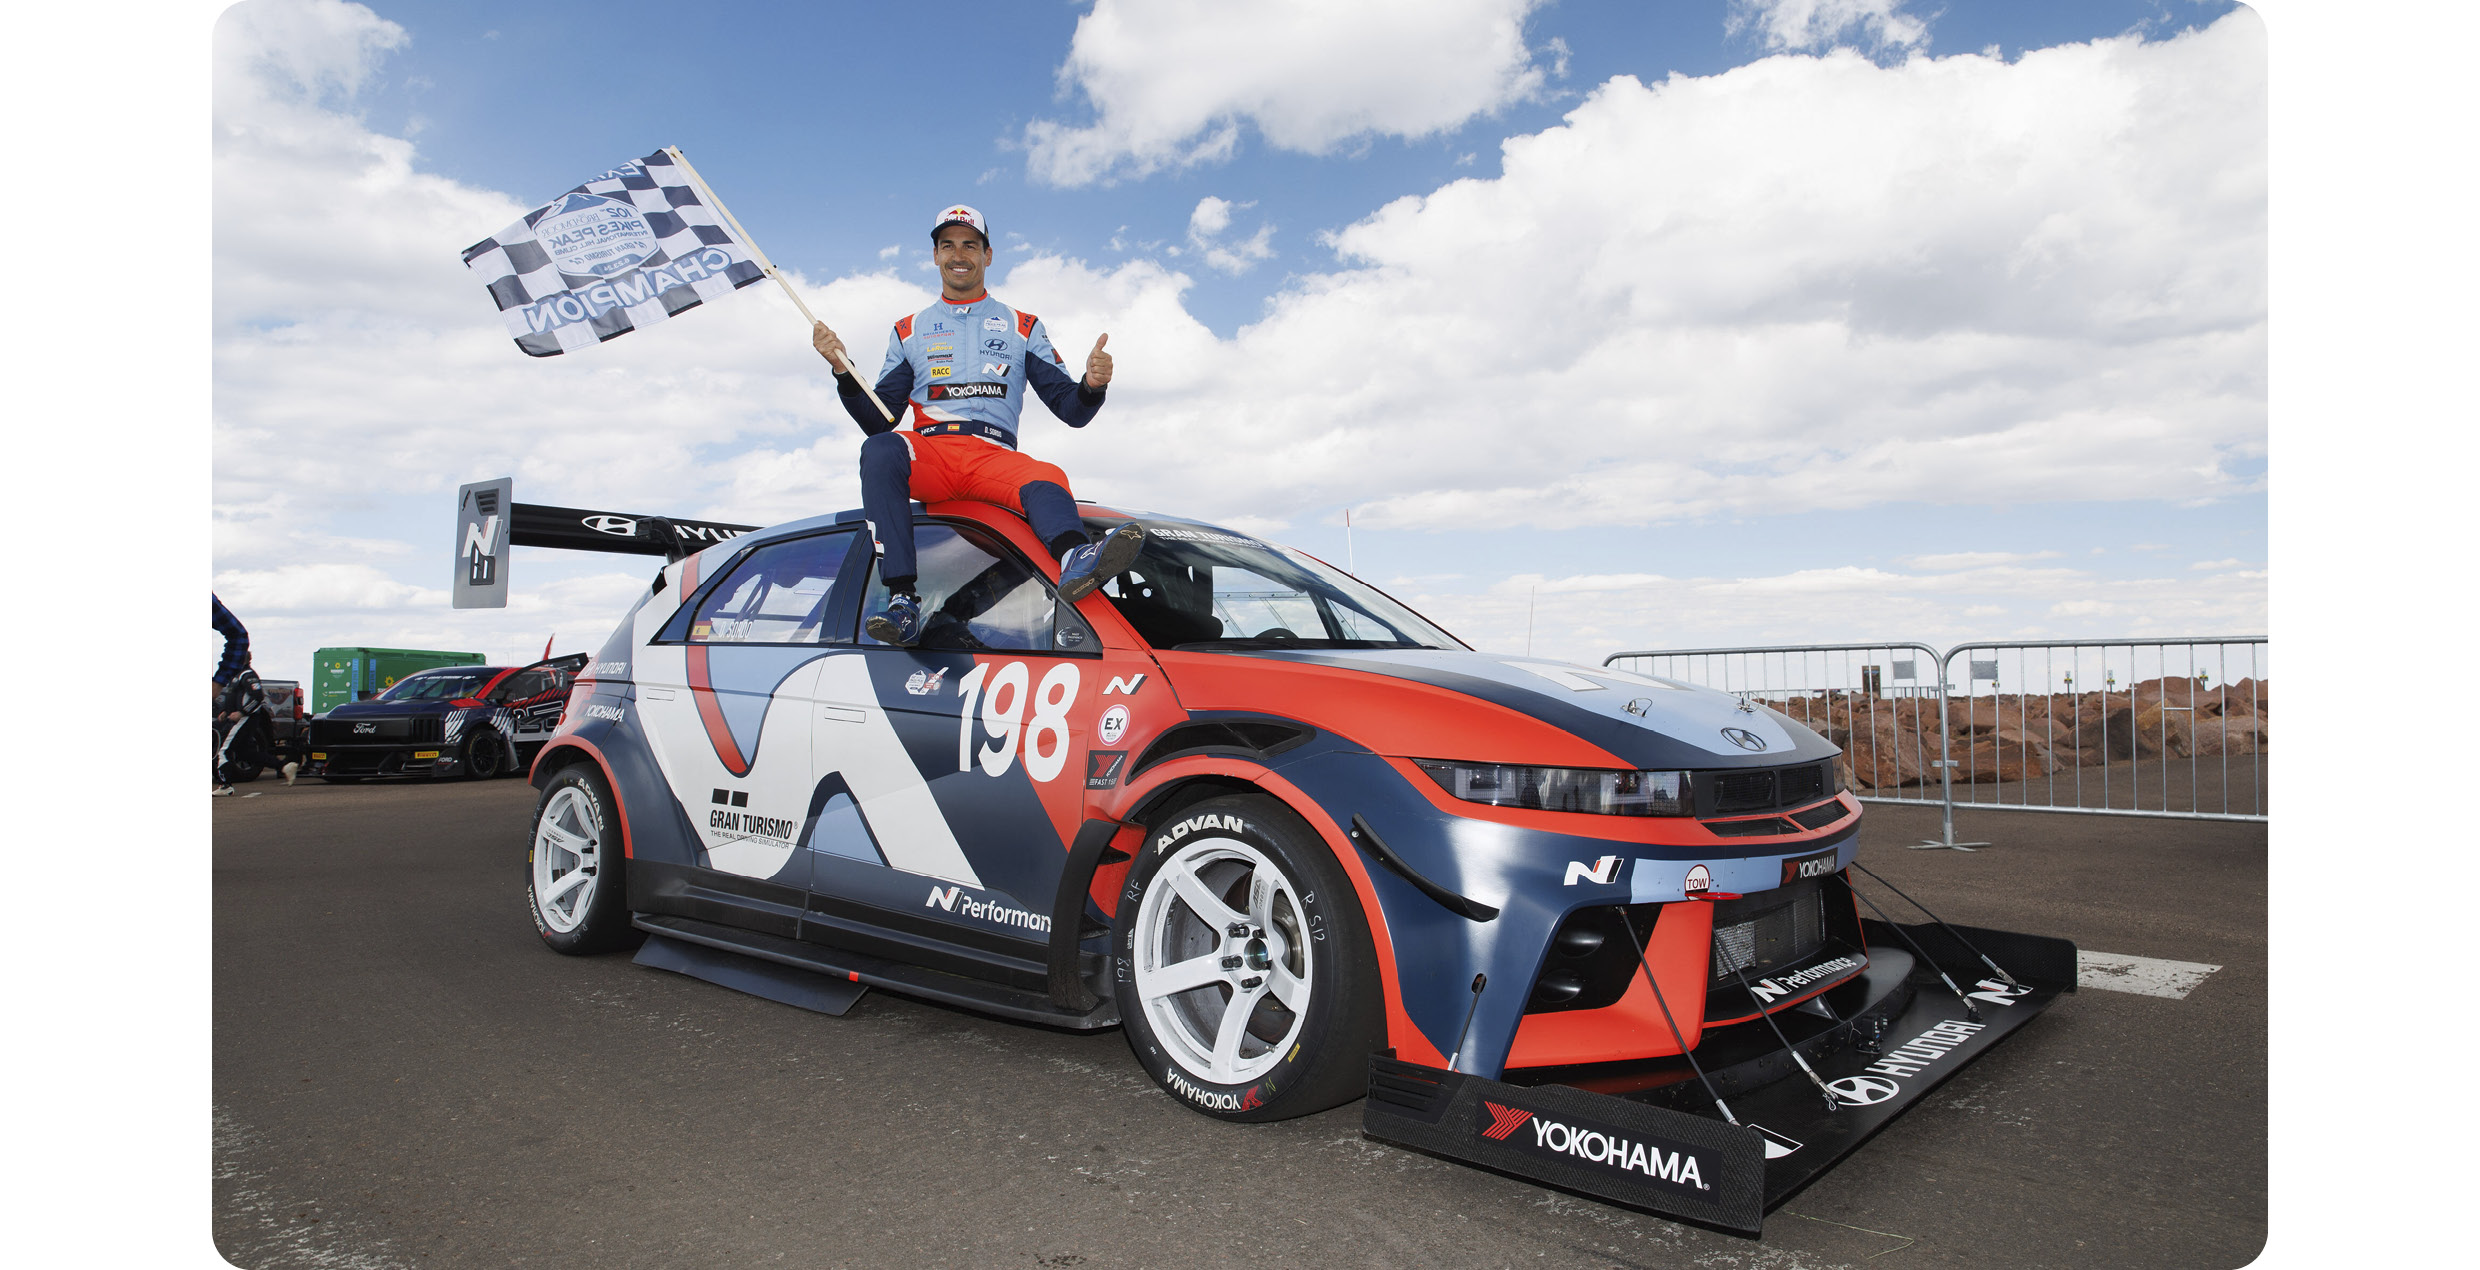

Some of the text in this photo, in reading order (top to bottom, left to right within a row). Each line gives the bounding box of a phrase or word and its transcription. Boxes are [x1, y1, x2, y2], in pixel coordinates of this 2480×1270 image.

[980, 350, 1012, 360] HYUNDAI
[932, 368, 950, 376] RACC
[946, 385, 1003, 397] YOKOHAMA
[1150, 528, 1198, 539] GRAN
[1196, 531, 1264, 548] TURISMO
[595, 662, 627, 675] HYUNDAI
[585, 704, 625, 722] YOKOHAMA
[958, 662, 1080, 782] 198
[1104, 718, 1123, 730] EX
[353, 723, 376, 734] Ford
[578, 777, 605, 832] ADVAN
[710, 809, 793, 840] GRAN TURISMO
[1156, 814, 1243, 855] ADVAN
[711, 830, 789, 850] THE REAL DRIVING SIMULATOR
[1799, 855, 1836, 879] YOKOHAMA
[1688, 877, 1708, 889] TOW
[527, 884, 546, 935] YOKOHAMA
[1117, 957, 1131, 983] 198
[1777, 956, 1857, 989] Performance
[1864, 1019, 1987, 1078] HYUNDAI
[1167, 1067, 1242, 1110] YOKOHAMA
[1531, 1116, 1705, 1190] YOKOHAMA
